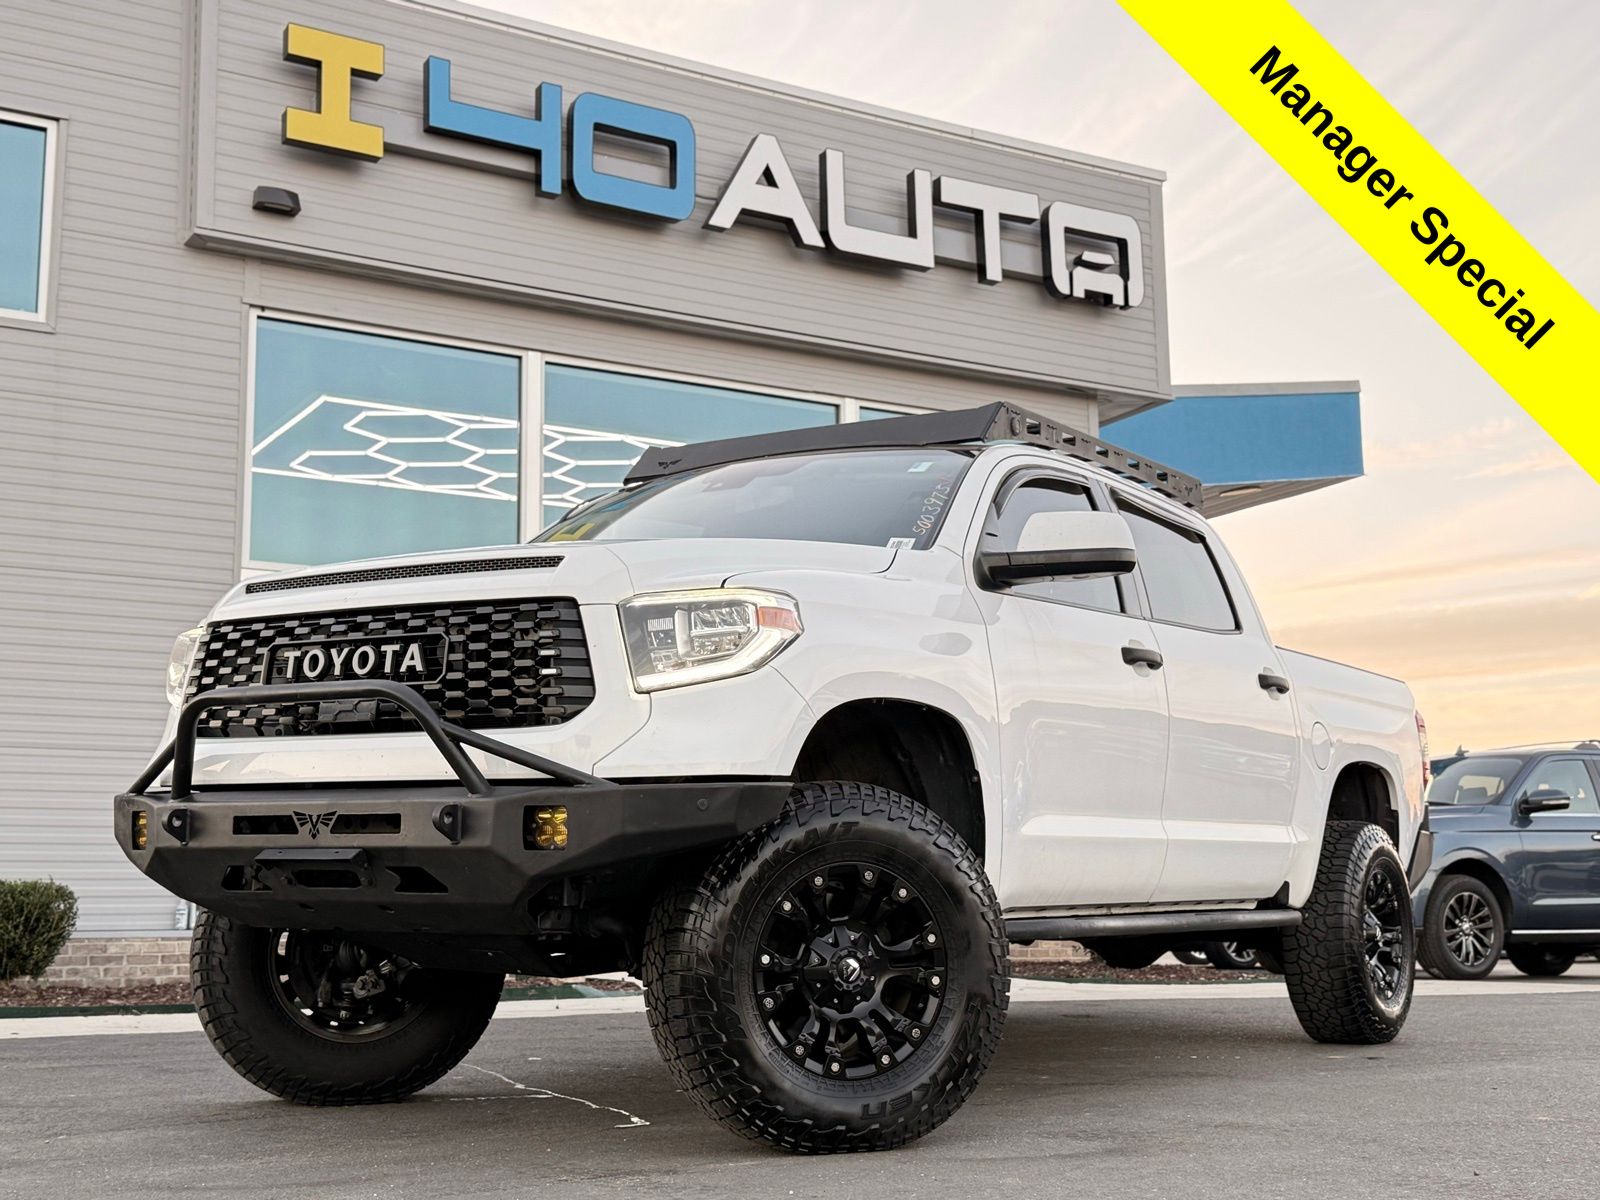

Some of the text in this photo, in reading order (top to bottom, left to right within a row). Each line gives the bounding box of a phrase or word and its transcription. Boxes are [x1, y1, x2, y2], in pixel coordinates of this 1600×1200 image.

[282, 23, 1144, 310] I 40 AUTO
[284, 643, 423, 679] TOYOTA
